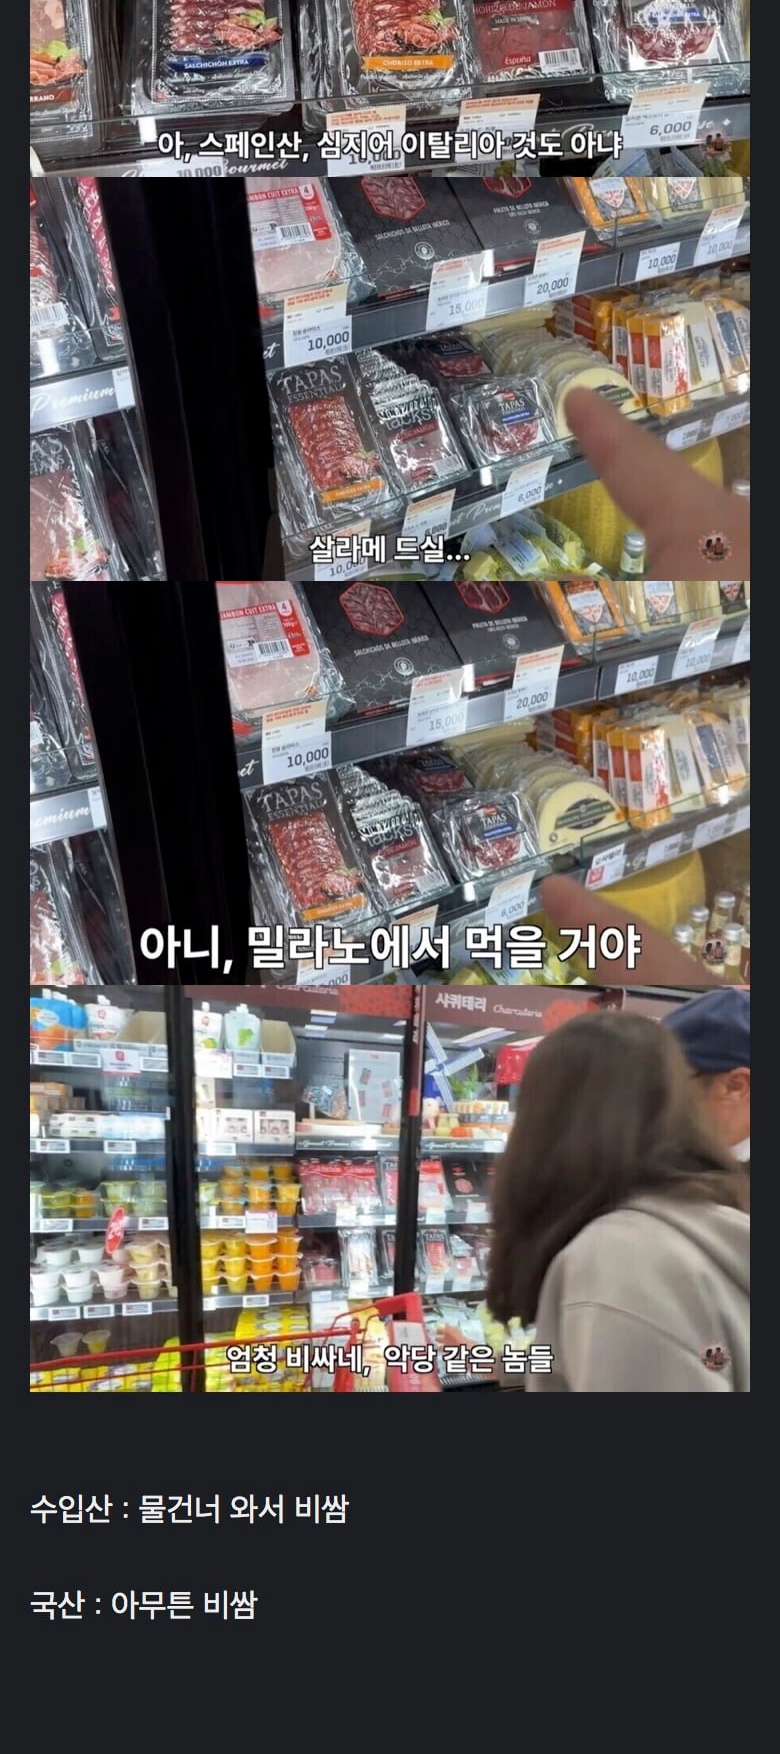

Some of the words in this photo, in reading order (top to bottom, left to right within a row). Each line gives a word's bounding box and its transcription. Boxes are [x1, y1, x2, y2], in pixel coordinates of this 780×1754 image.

[184, 61, 227, 70] SALCHICHÓN
[228, 59, 249, 68] EXTRA
[504, 56, 532, 66] Espuña
[650, 121, 692, 136] 6,000
[303, 186, 310, 196] 4
[648, 254, 676, 269] 10,000
[536, 277, 569, 295] 20,000
[308, 331, 350, 351] 10,000
[276, 365, 343, 395] TAPAS
[30, 385, 114, 413] Premium
[499, 399, 525, 410] TAPAS
[245, 606, 257, 616] CUIT
[258, 603, 276, 613] EXTRA
[281, 603, 289, 612] 4
[626, 667, 655, 684] 10,000
[516, 691, 549, 710] 20,000
[429, 713, 464, 731] 15,000
[287, 747, 330, 768] 10,000
[257, 783, 324, 814] TAPAS
[481, 813, 508, 826] TAPAS
[435, 992, 487, 1013] 샤퀴테리
